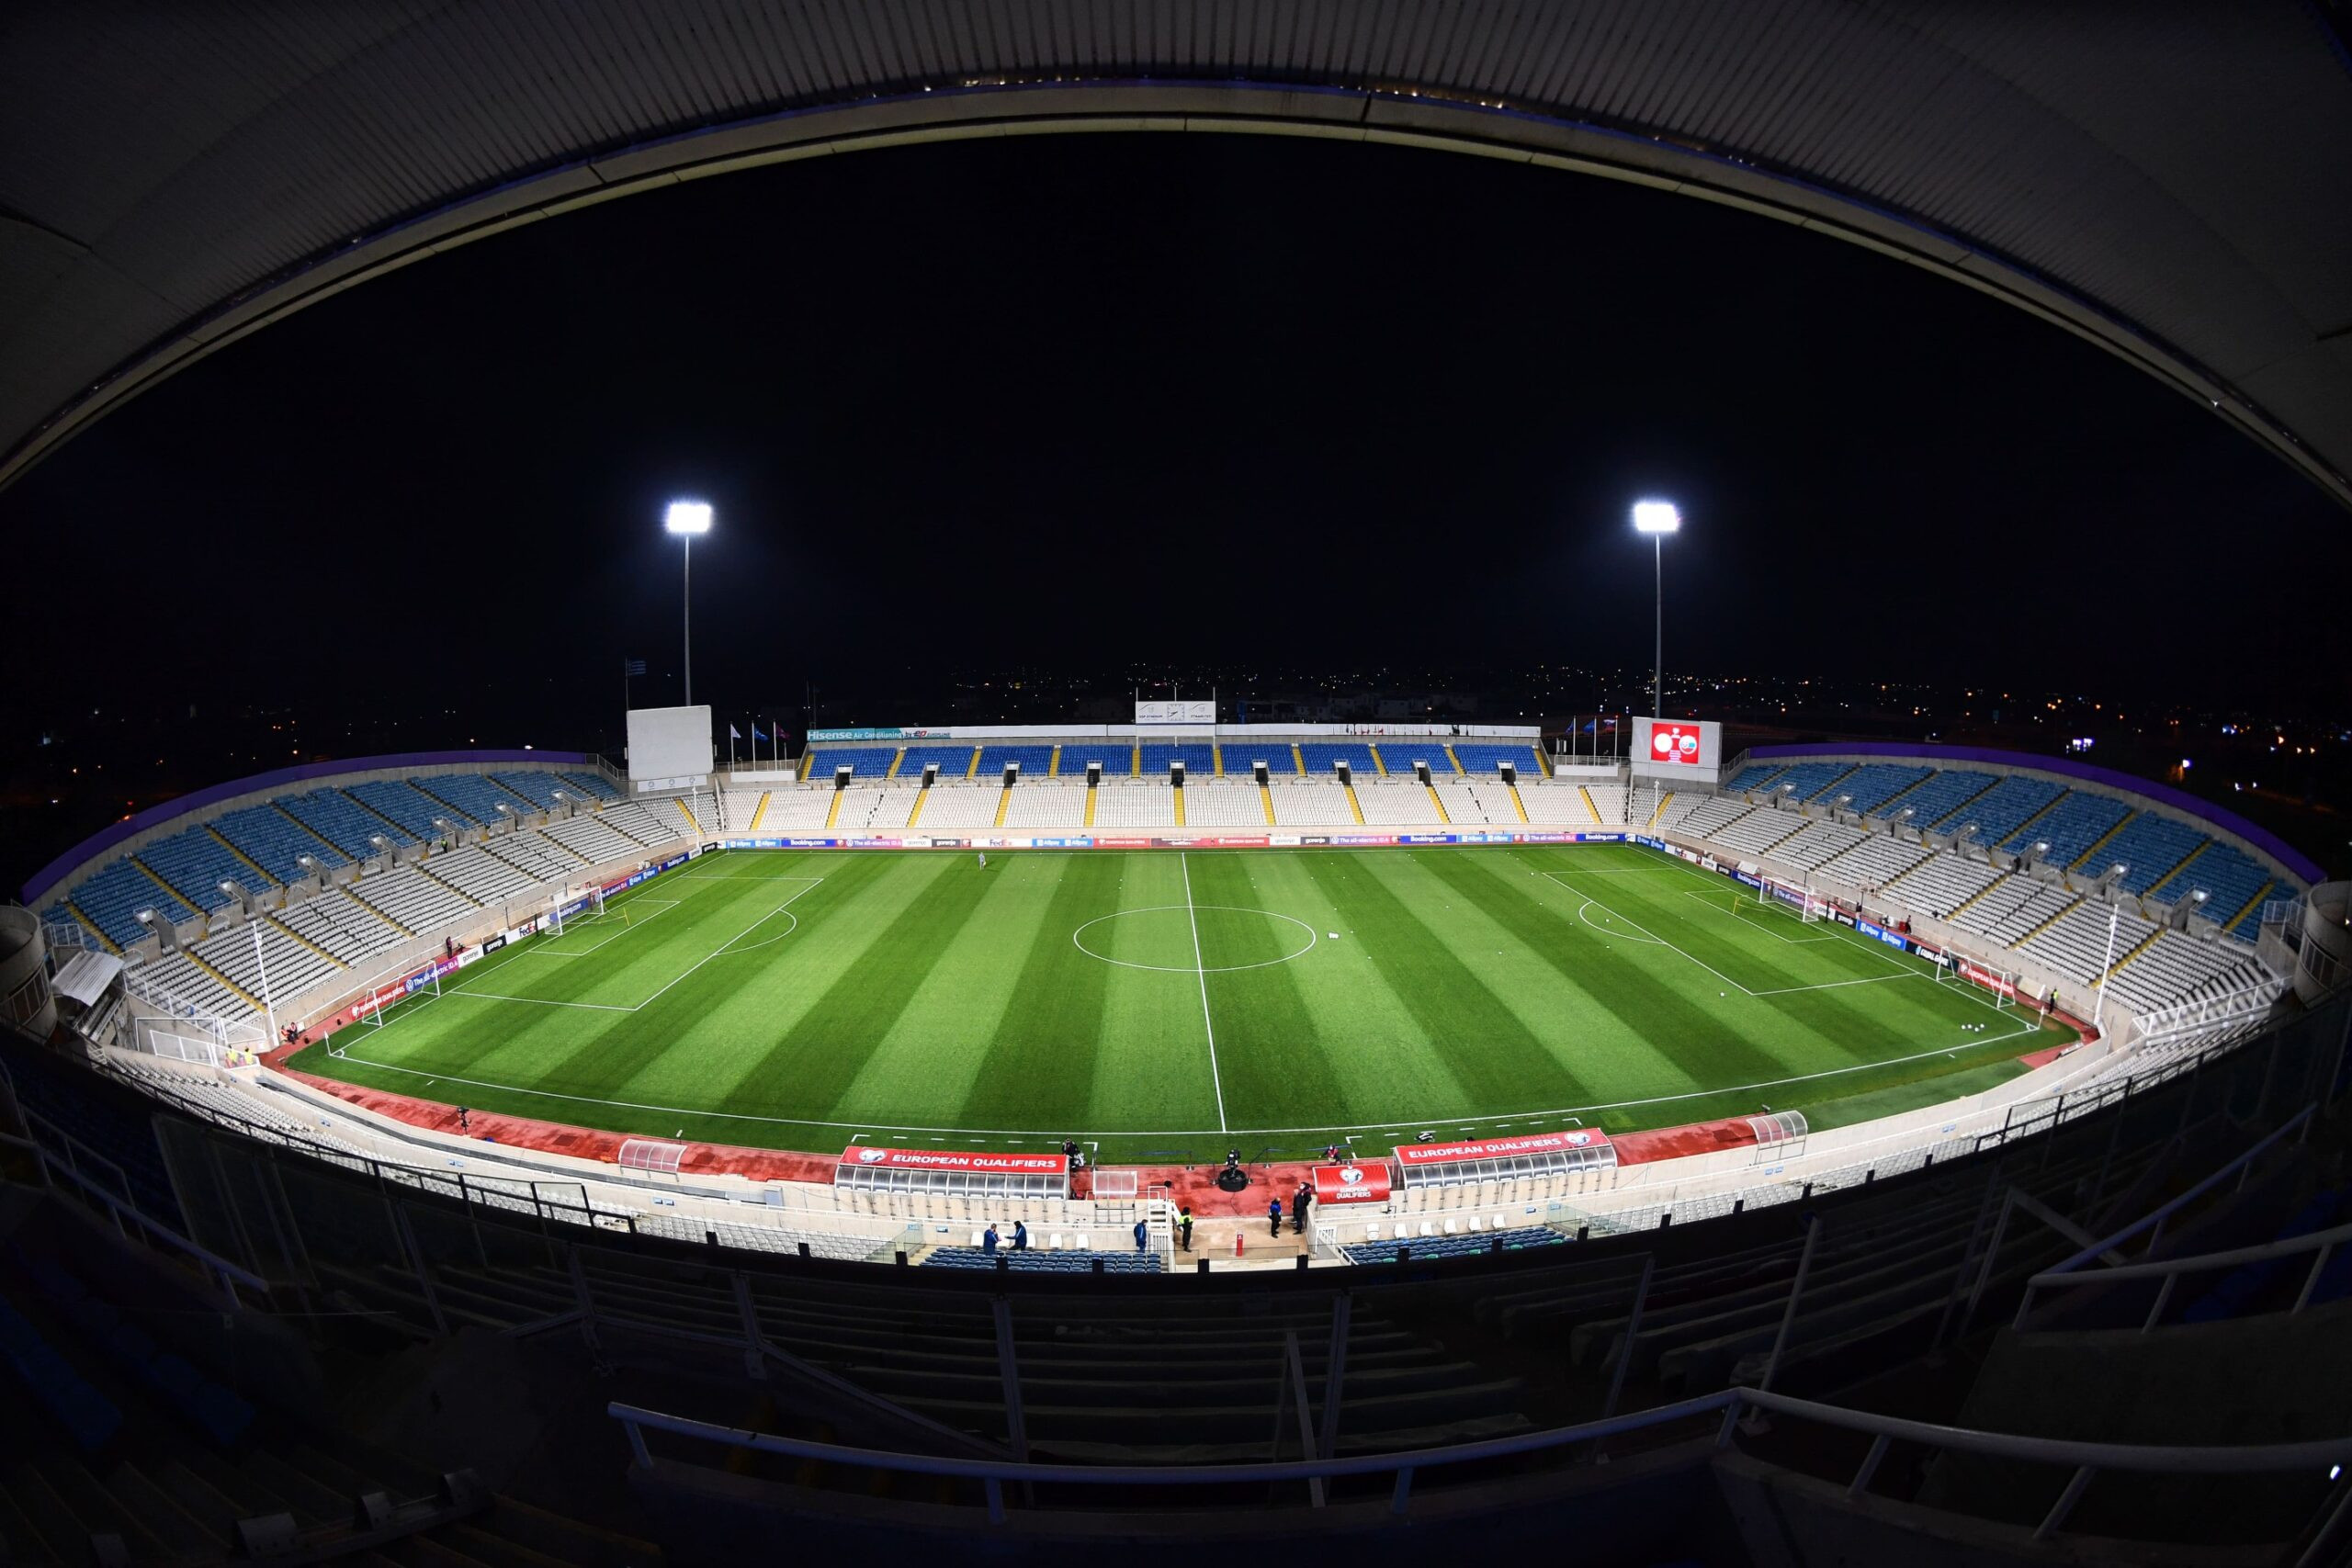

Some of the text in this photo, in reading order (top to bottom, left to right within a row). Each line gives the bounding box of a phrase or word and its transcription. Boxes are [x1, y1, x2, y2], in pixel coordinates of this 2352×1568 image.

[808, 730, 852, 740] Hisense
[864, 731, 901, 739] Conditioning
[559, 903, 582, 917] ooking.com
[462, 950, 479, 963] gorenje
[413, 977, 423, 987] The
[1408, 1138, 1561, 1158] EUROPEAN QUALIFIERS
[892, 1155, 1057, 1168] EUROPEAN QUALIFIERS
[1336, 1191, 1372, 1200] QUALIFIERS
